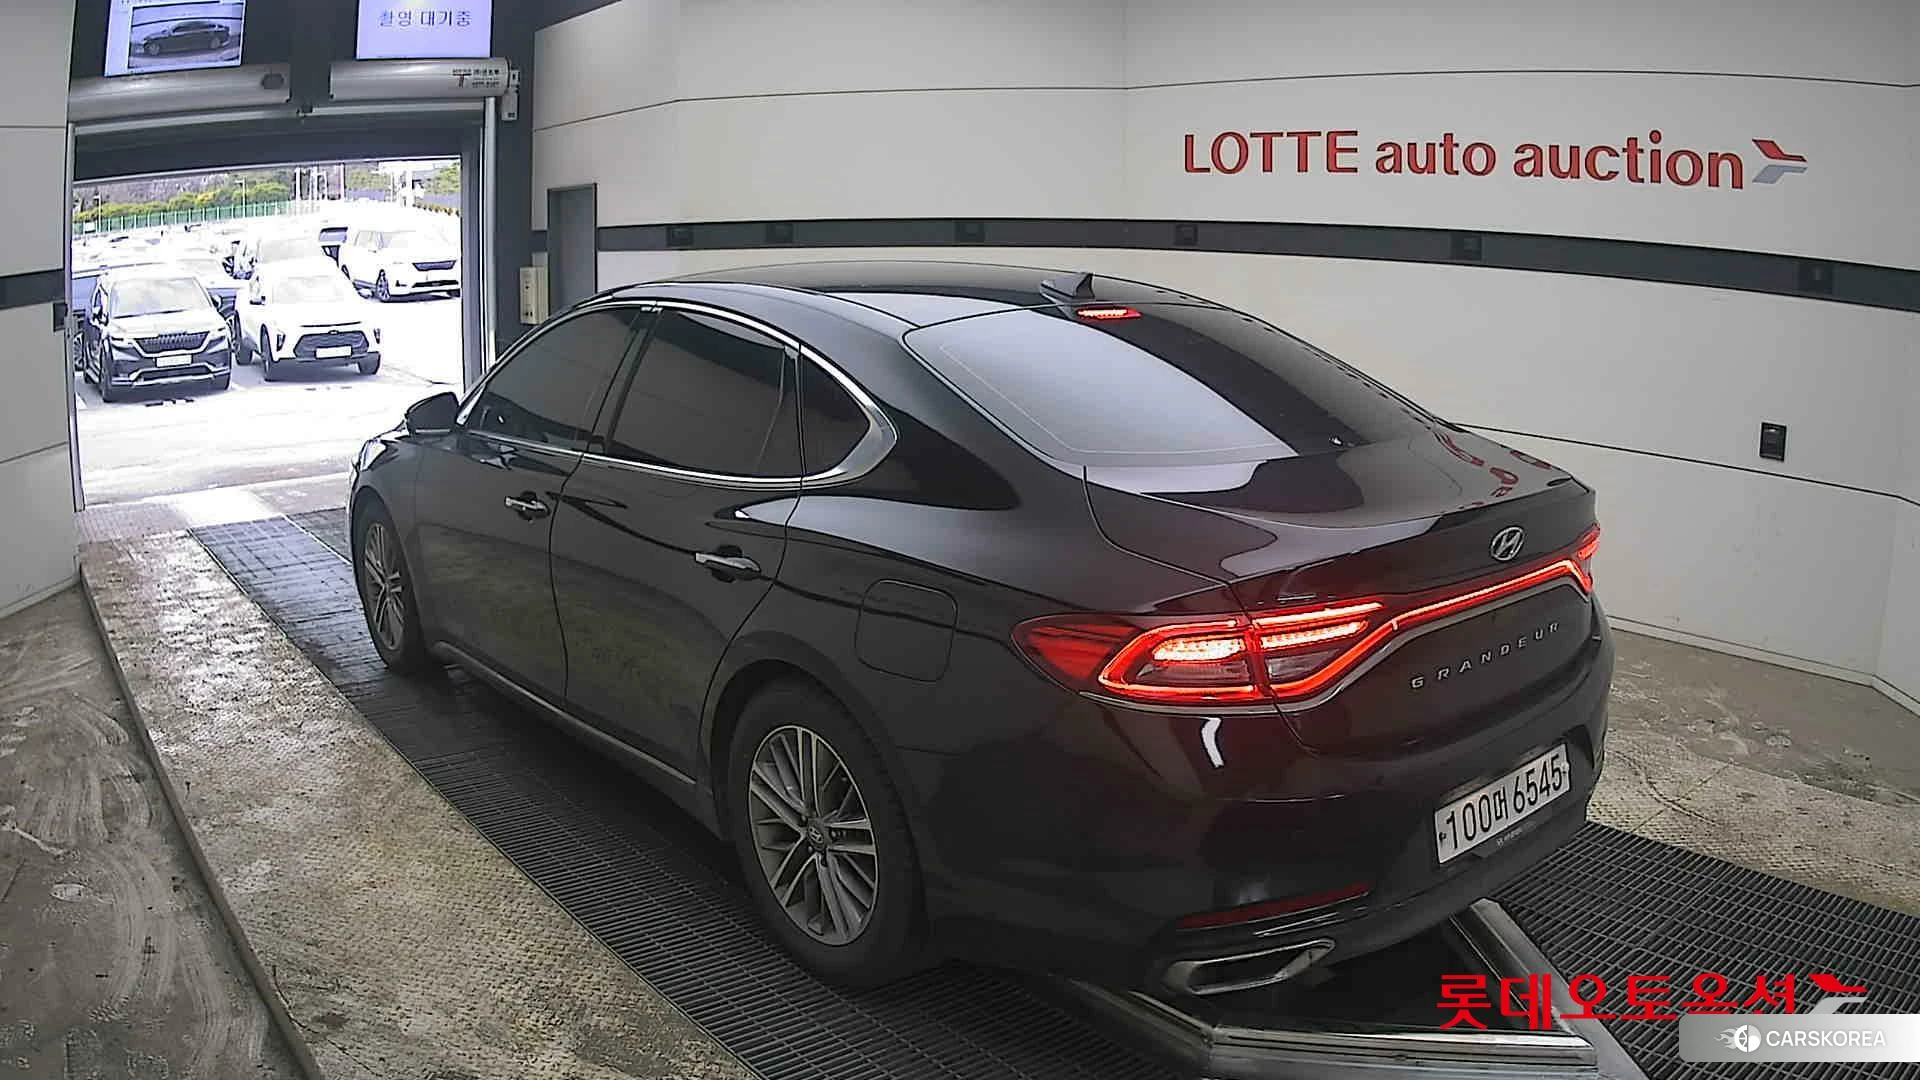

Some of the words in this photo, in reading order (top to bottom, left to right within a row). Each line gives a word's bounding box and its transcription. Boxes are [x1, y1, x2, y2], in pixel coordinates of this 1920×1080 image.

[1184, 130, 1359, 175] LOTTE
[1375, 132, 1497, 177] auto
[1513, 129, 1744, 190] auction
[1410, 622, 1559, 689] GRANDEUR
